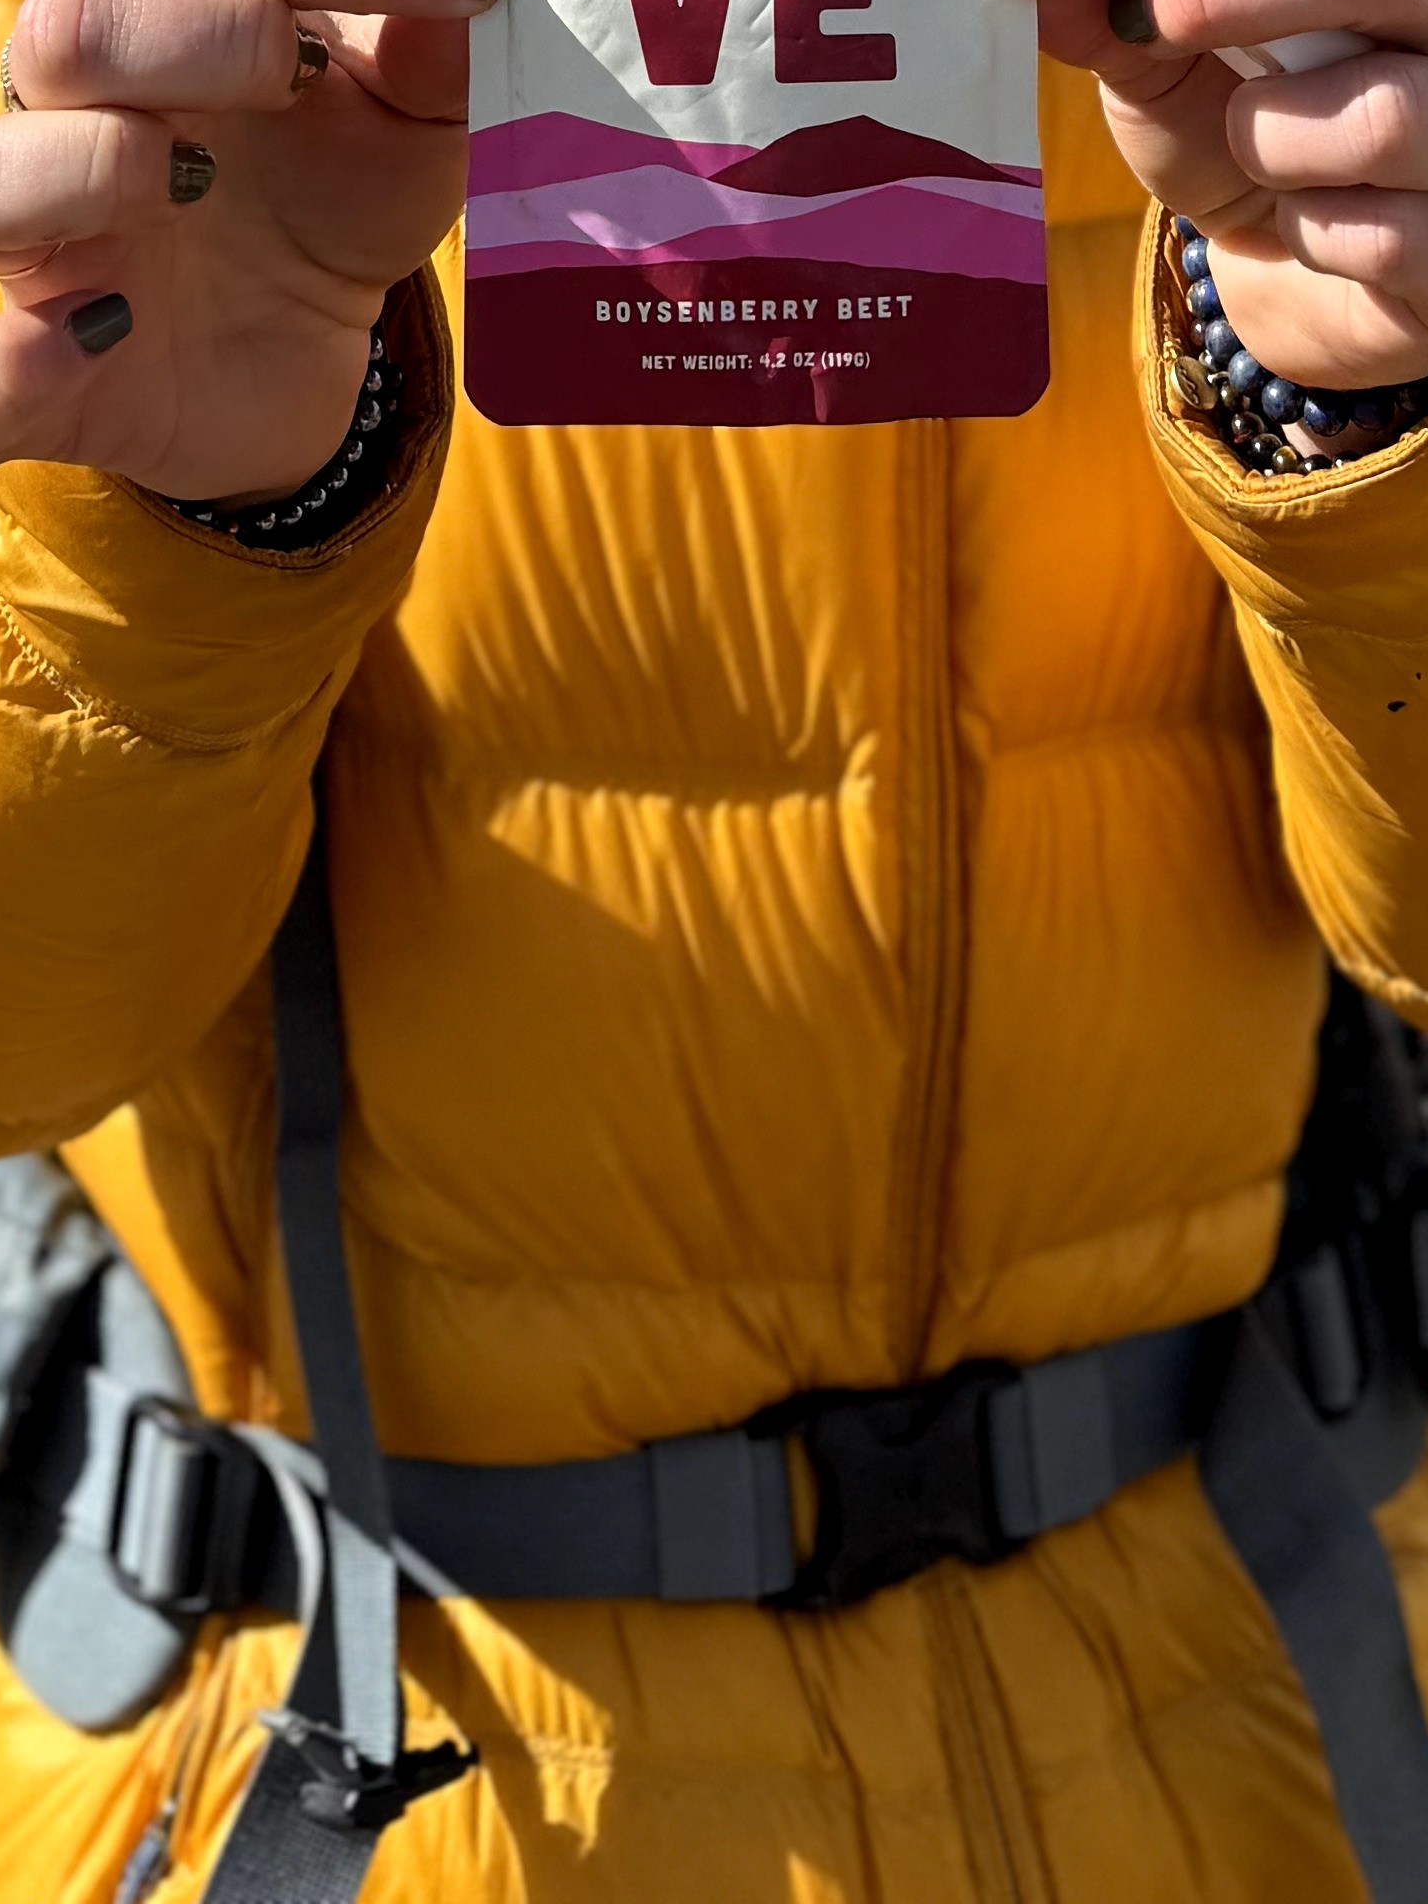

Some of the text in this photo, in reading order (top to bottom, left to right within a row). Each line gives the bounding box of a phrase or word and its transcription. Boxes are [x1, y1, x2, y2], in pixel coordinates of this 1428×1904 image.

[596, 295, 913, 323] BOYSENBERRY BEET
[641, 351, 870, 370] NET WEIGHT: 4.2 OZ (119G)
